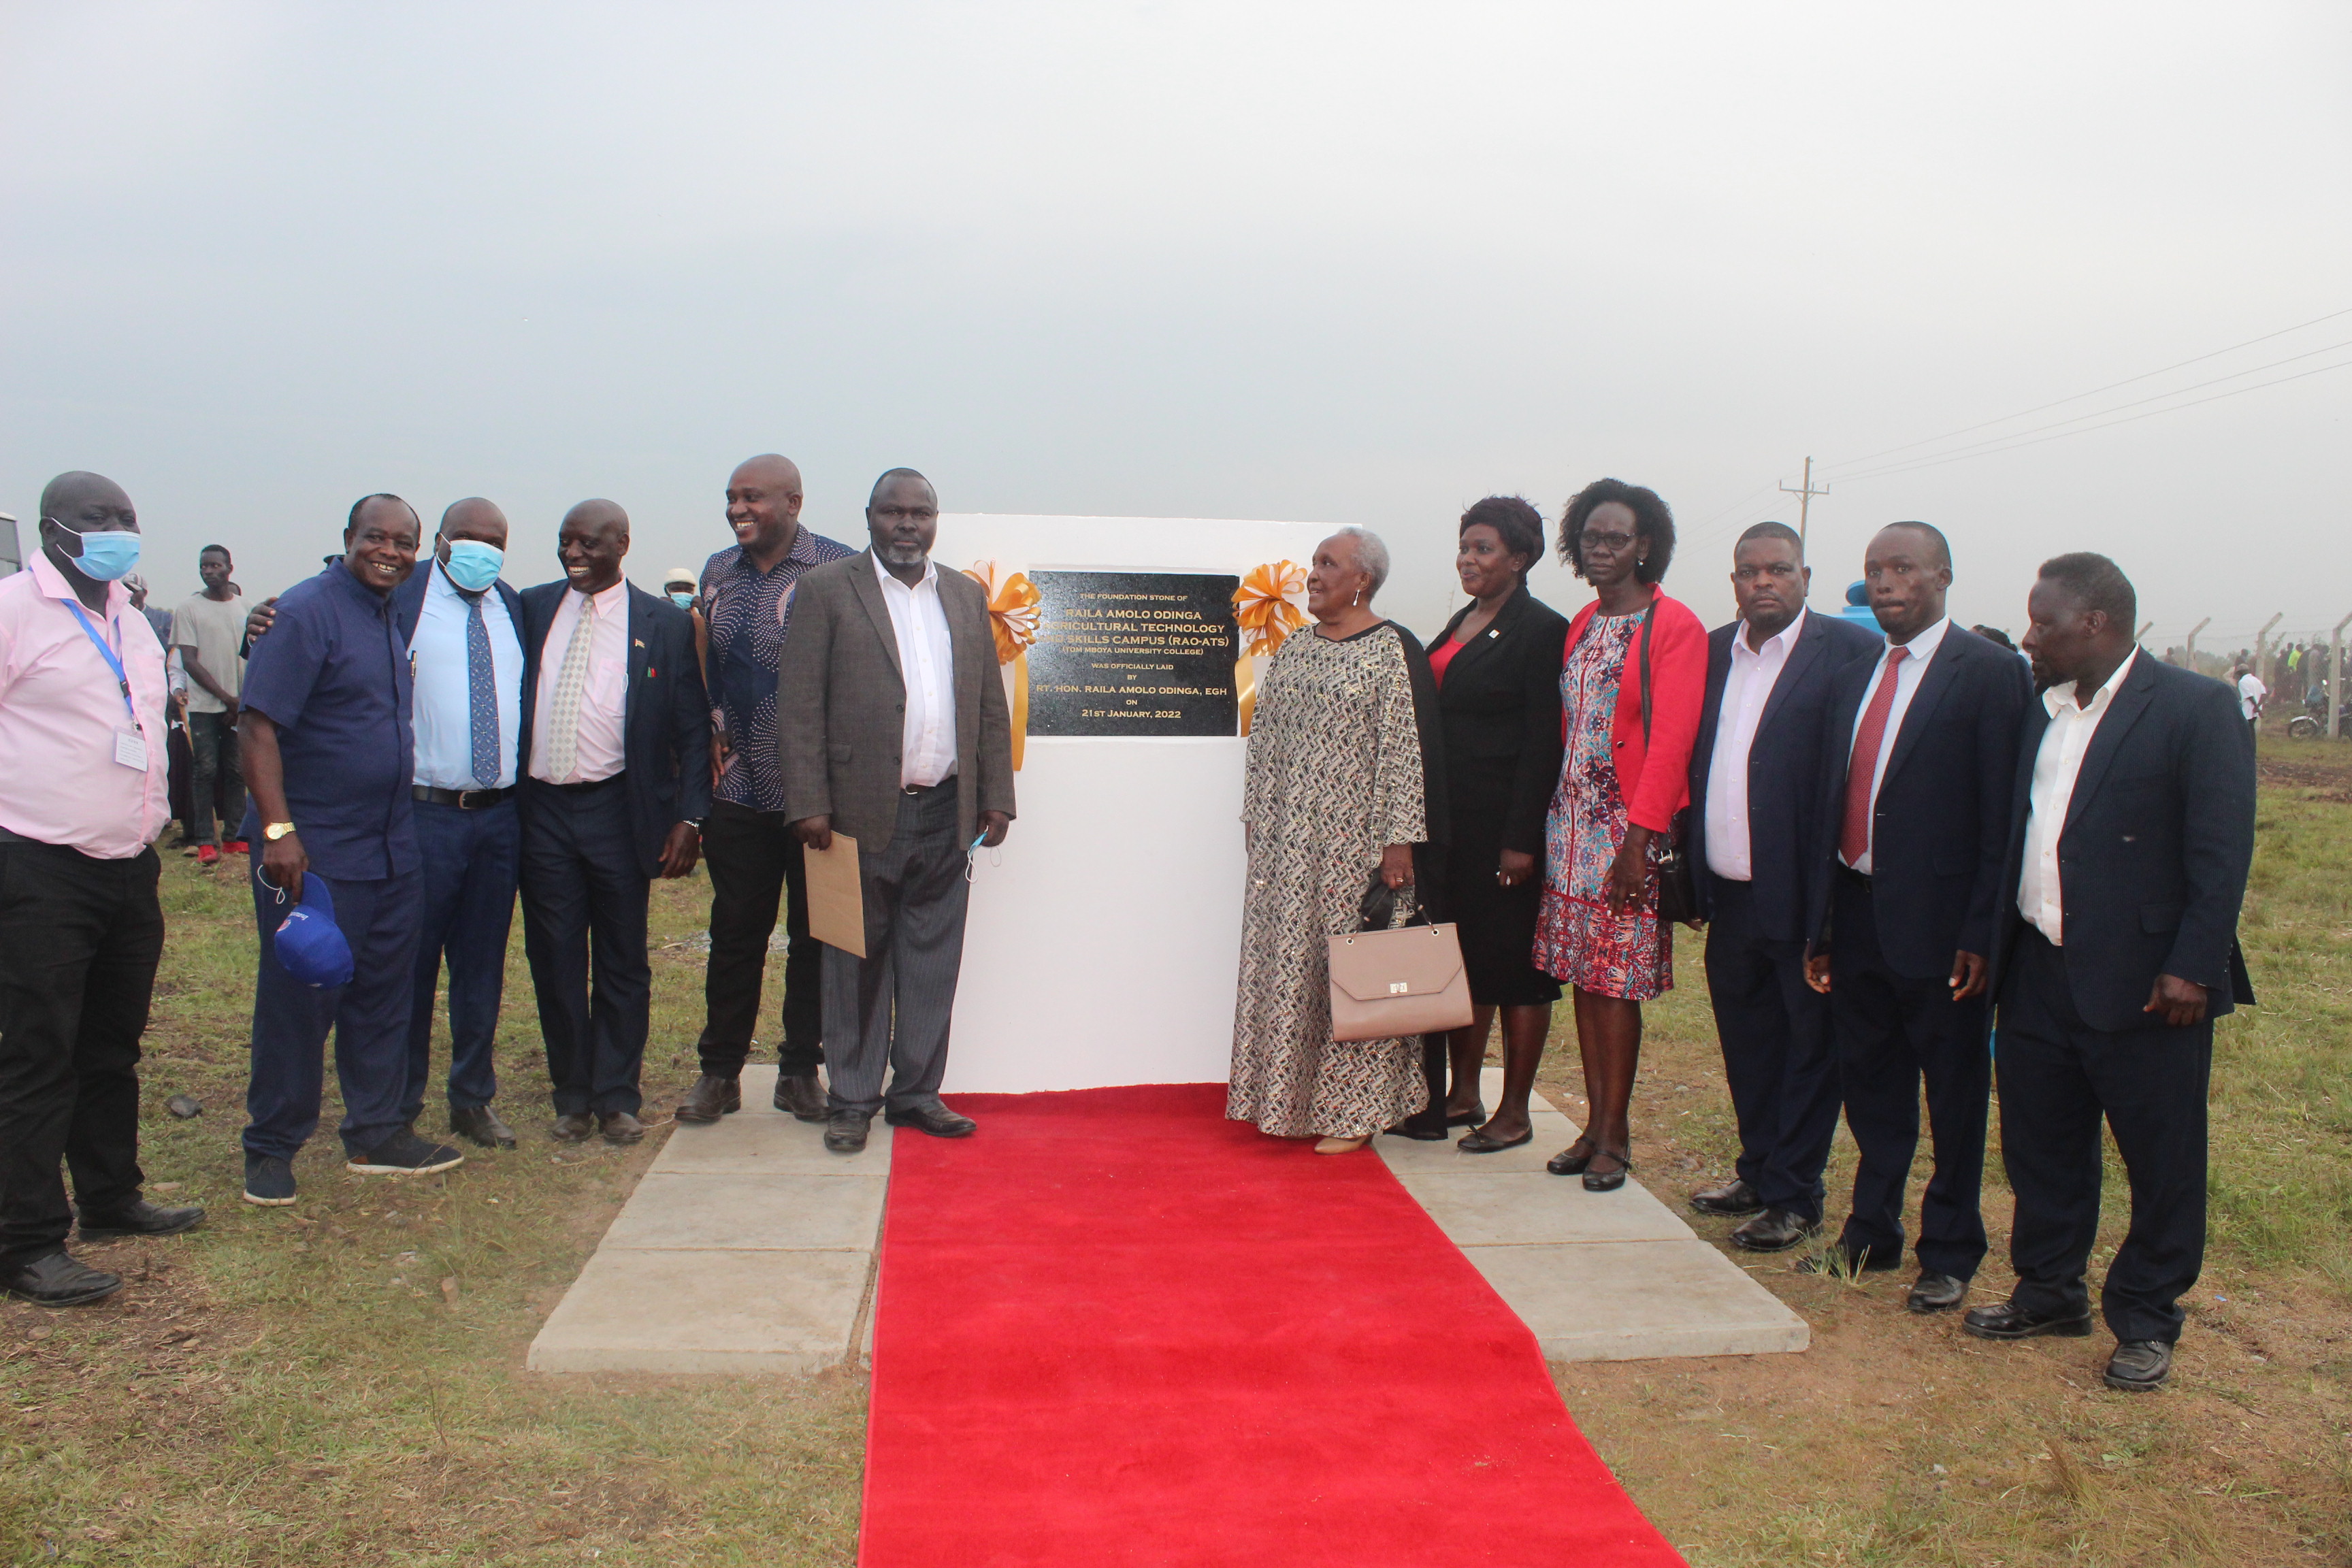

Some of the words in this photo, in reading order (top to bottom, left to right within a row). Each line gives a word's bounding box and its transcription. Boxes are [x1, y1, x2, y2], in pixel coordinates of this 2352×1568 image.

[1066, 608, 1102, 618] RAILA
[1106, 609, 1150, 619] AMOLO
[1153, 610, 1202, 620] ODINGA
[1042, 621, 1139, 632] AGRICULTURAL
[1141, 623, 1225, 634] TECHNOLOGY
[1038, 634, 1064, 643] AND
[1066, 635, 1110, 644] SKILLS
[1112, 636, 1165, 645] CAMPUS
[1168, 634, 1229, 647] (RAO-ATS)
[1163, 648, 1204, 656] COLLEGE)
[1056, 685, 1082, 693] HON.
[1085, 685, 1116, 693] RAILA
[1119, 686, 1156, 694] AMOLO
[1158, 687, 1203, 696] ODINGA,
[1205, 687, 1227, 696] EGH
[1154, 710, 1181, 719] 2022
